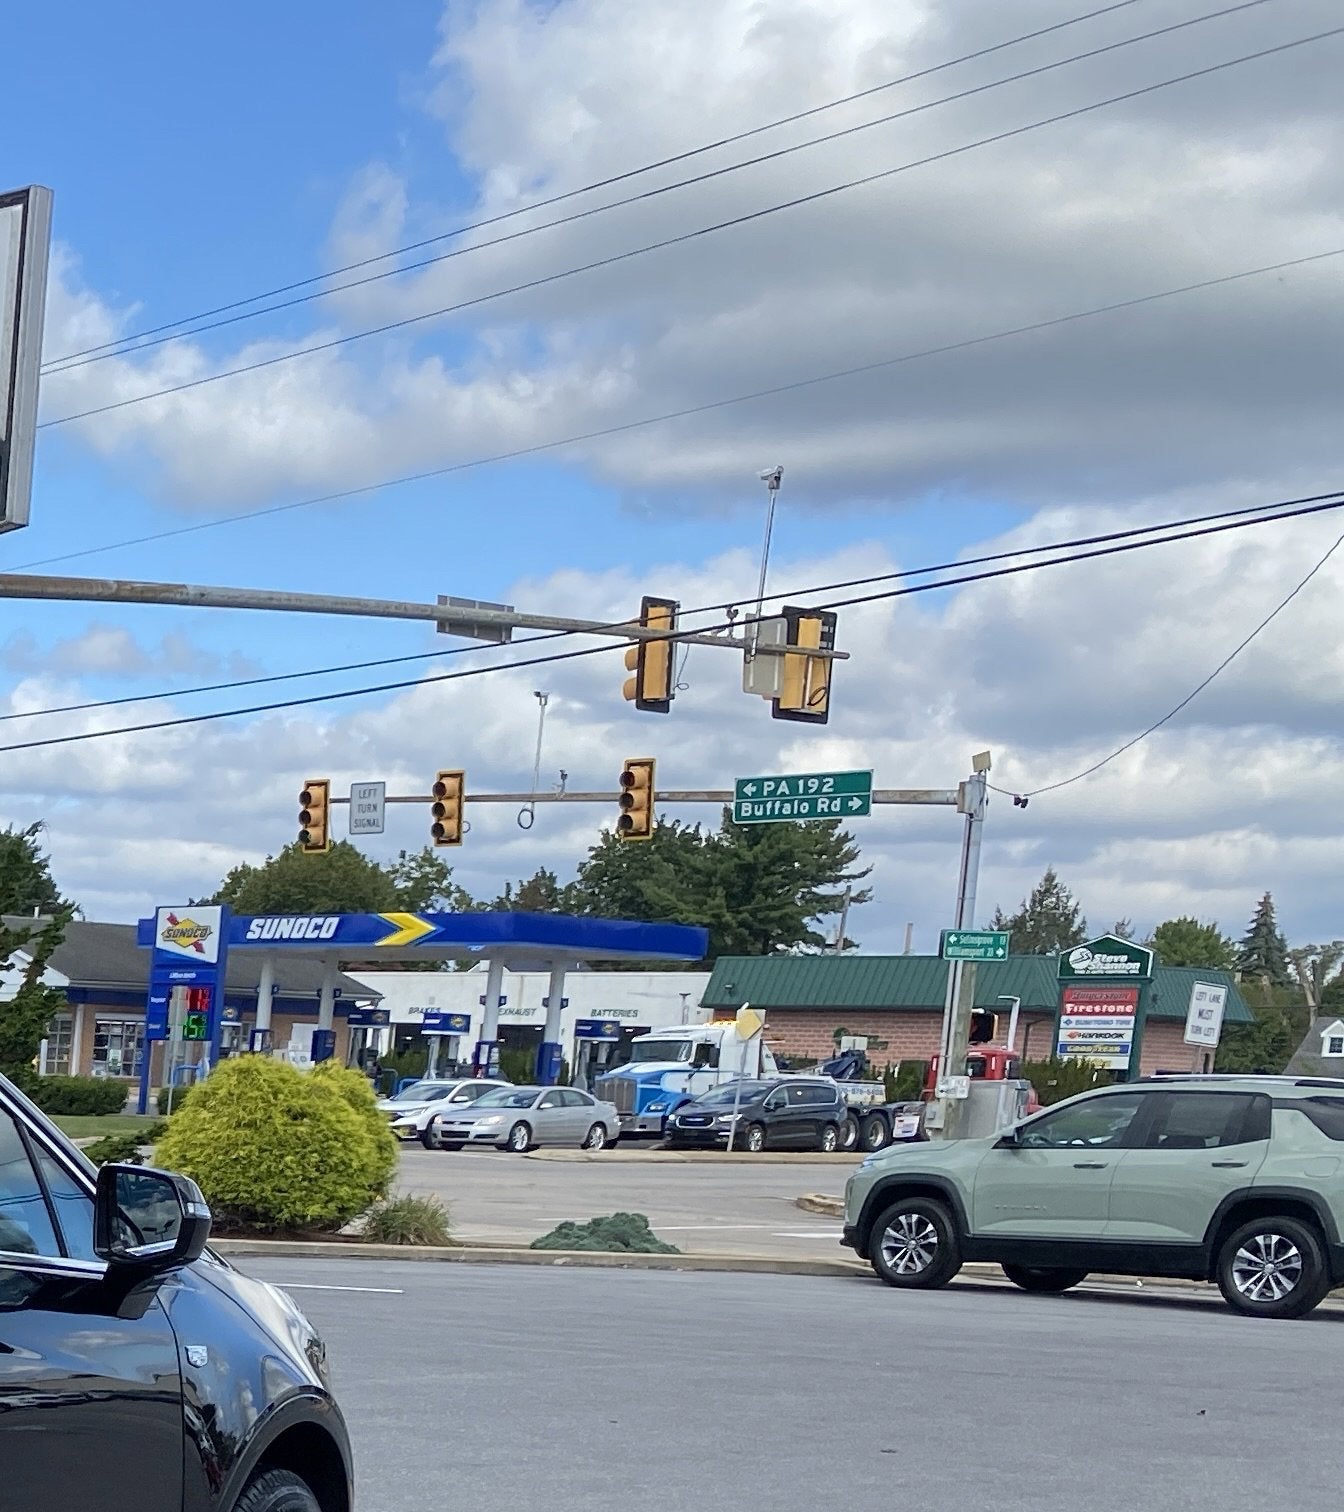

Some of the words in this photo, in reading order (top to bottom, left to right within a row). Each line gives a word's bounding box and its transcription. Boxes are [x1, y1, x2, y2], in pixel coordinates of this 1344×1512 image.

[763, 781, 790, 796] PA
[798, 778, 834, 794] 192
[358, 788, 377, 799] LEFT
[357, 803, 378, 813] TURN
[741, 800, 809, 817] Buffalo
[817, 797, 841, 813] Rd
[354, 818, 380, 828] SIGNAL
[164, 927, 209, 939] SUNOCO
[246, 917, 340, 939] SUNOCO
[1092, 953, 1128, 963] Steve
[1088, 962, 1141, 970] Shannon
[591, 1008, 639, 1018] BATTERIES
[1065, 1003, 1134, 1014] Firestone
